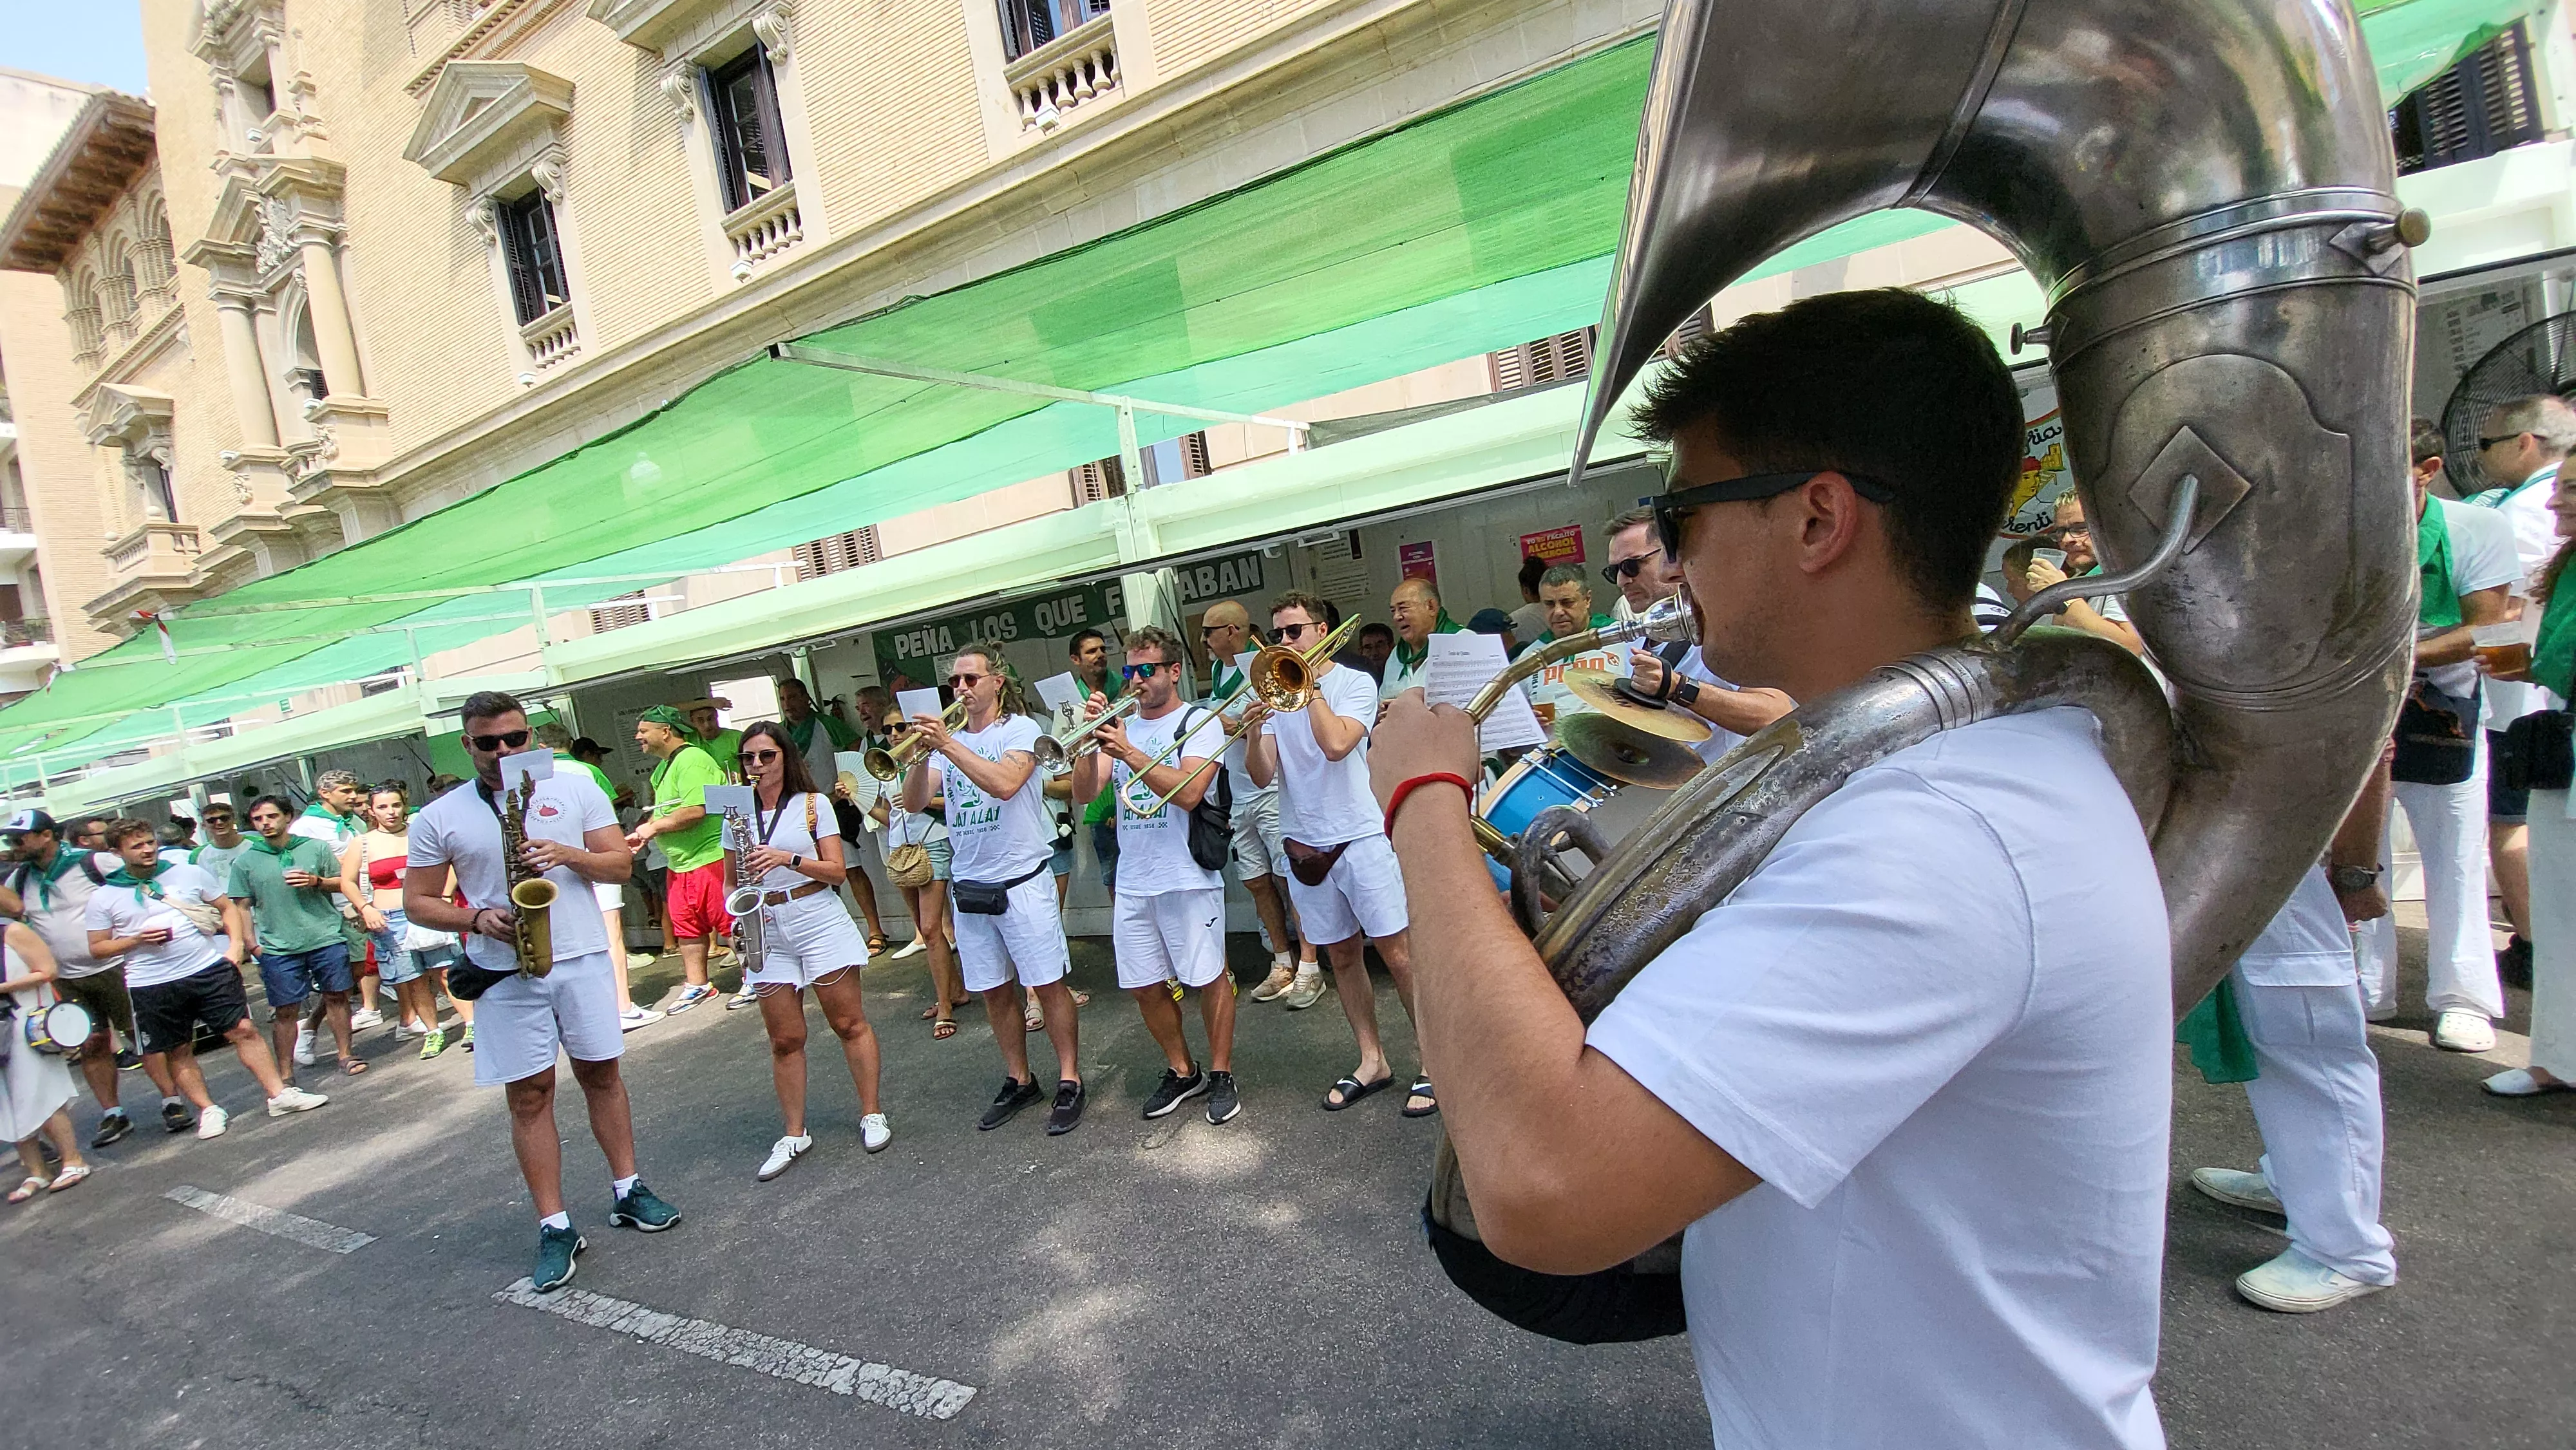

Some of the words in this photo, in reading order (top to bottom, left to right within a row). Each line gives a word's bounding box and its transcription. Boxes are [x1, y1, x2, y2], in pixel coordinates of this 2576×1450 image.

[1528, 537, 1576, 554] ALCOHOL
[894, 623, 955, 660] PEÑA
[969, 612, 1018, 645] LOS
[1034, 594, 1088, 636] QUE
[970, 805, 1001, 826] ALAI
